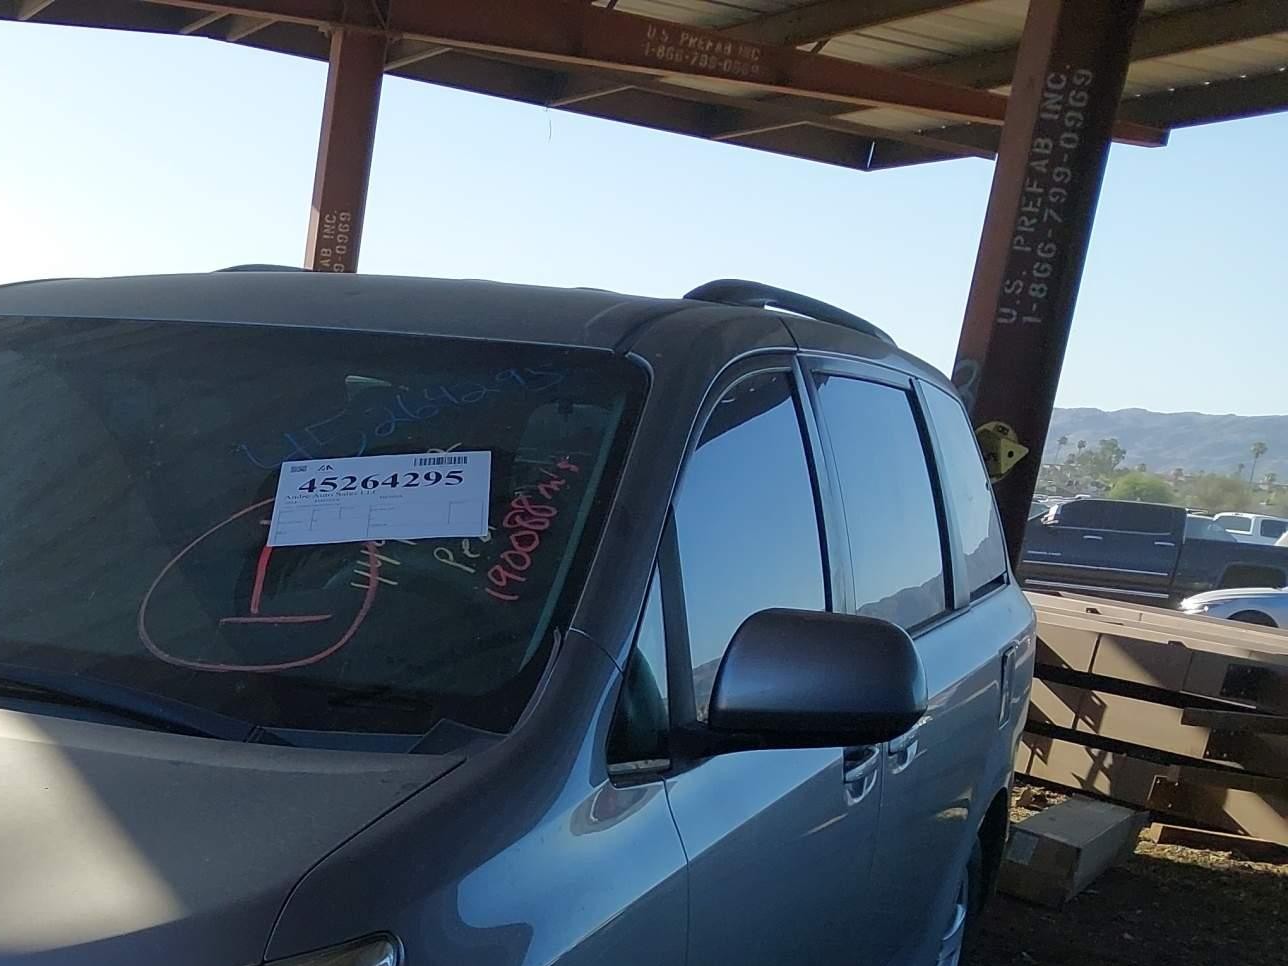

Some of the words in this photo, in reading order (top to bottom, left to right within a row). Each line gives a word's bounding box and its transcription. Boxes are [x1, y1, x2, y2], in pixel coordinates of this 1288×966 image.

[322, 209, 337, 240] INC.
[997, 271, 1028, 324] U.S.
[1013, 137, 1054, 252] PREFAB
[1040, 64, 1071, 120] INC.
[1022, 69, 1093, 324] 1-866-799-0969
[298, 470, 464, 493] 45264295
